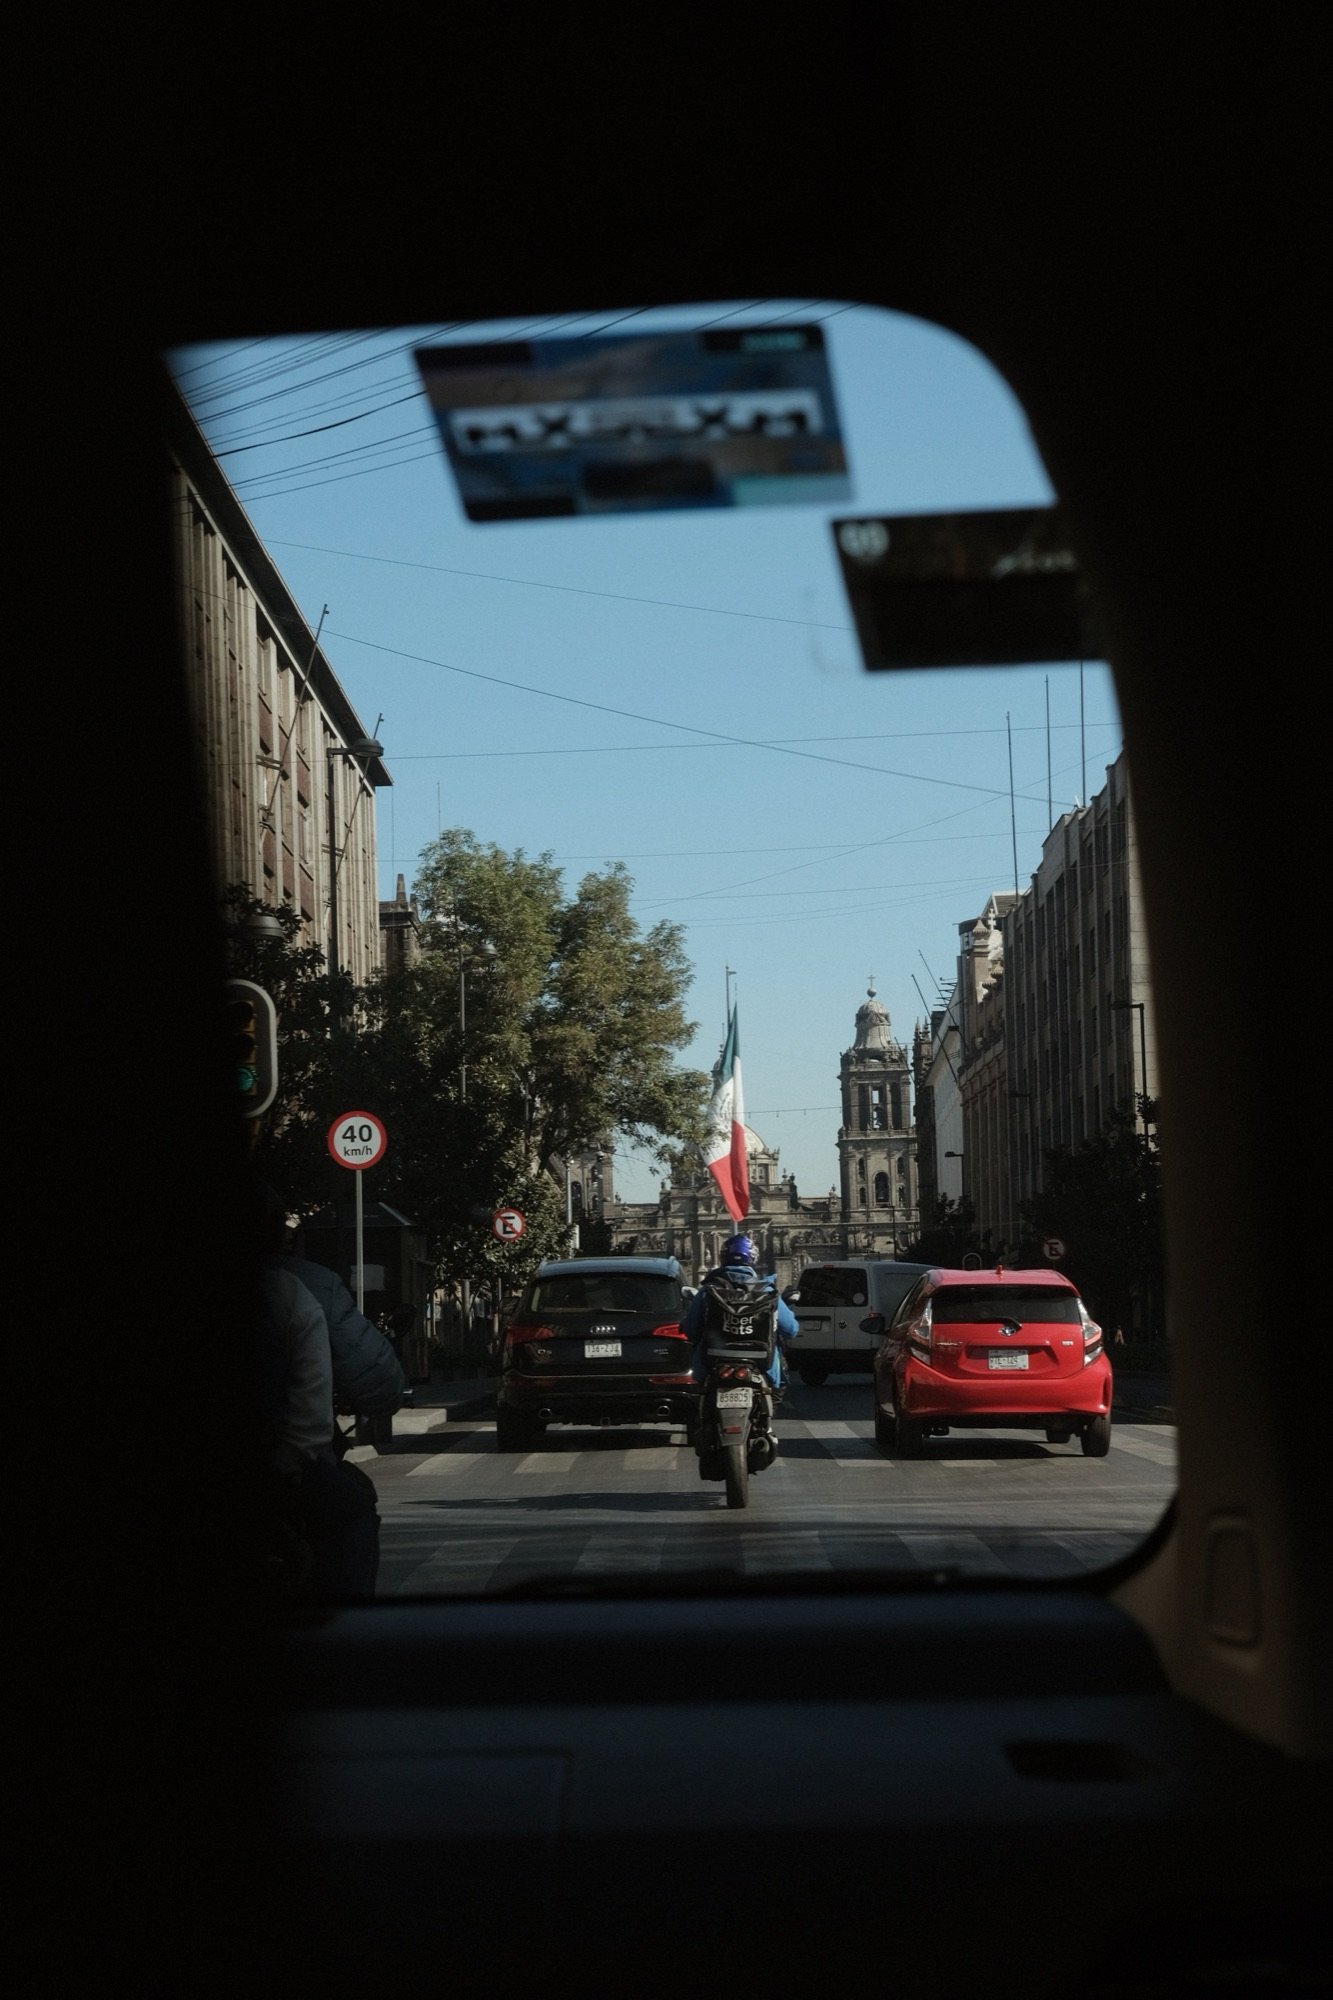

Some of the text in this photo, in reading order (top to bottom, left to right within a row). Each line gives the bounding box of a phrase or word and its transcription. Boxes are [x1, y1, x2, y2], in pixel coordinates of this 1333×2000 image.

[342, 1124, 373, 1143] 40
[343, 1145, 373, 1156] km/h
[723, 1311, 755, 1326] Uber
[722, 1323, 754, 1336] Eats
